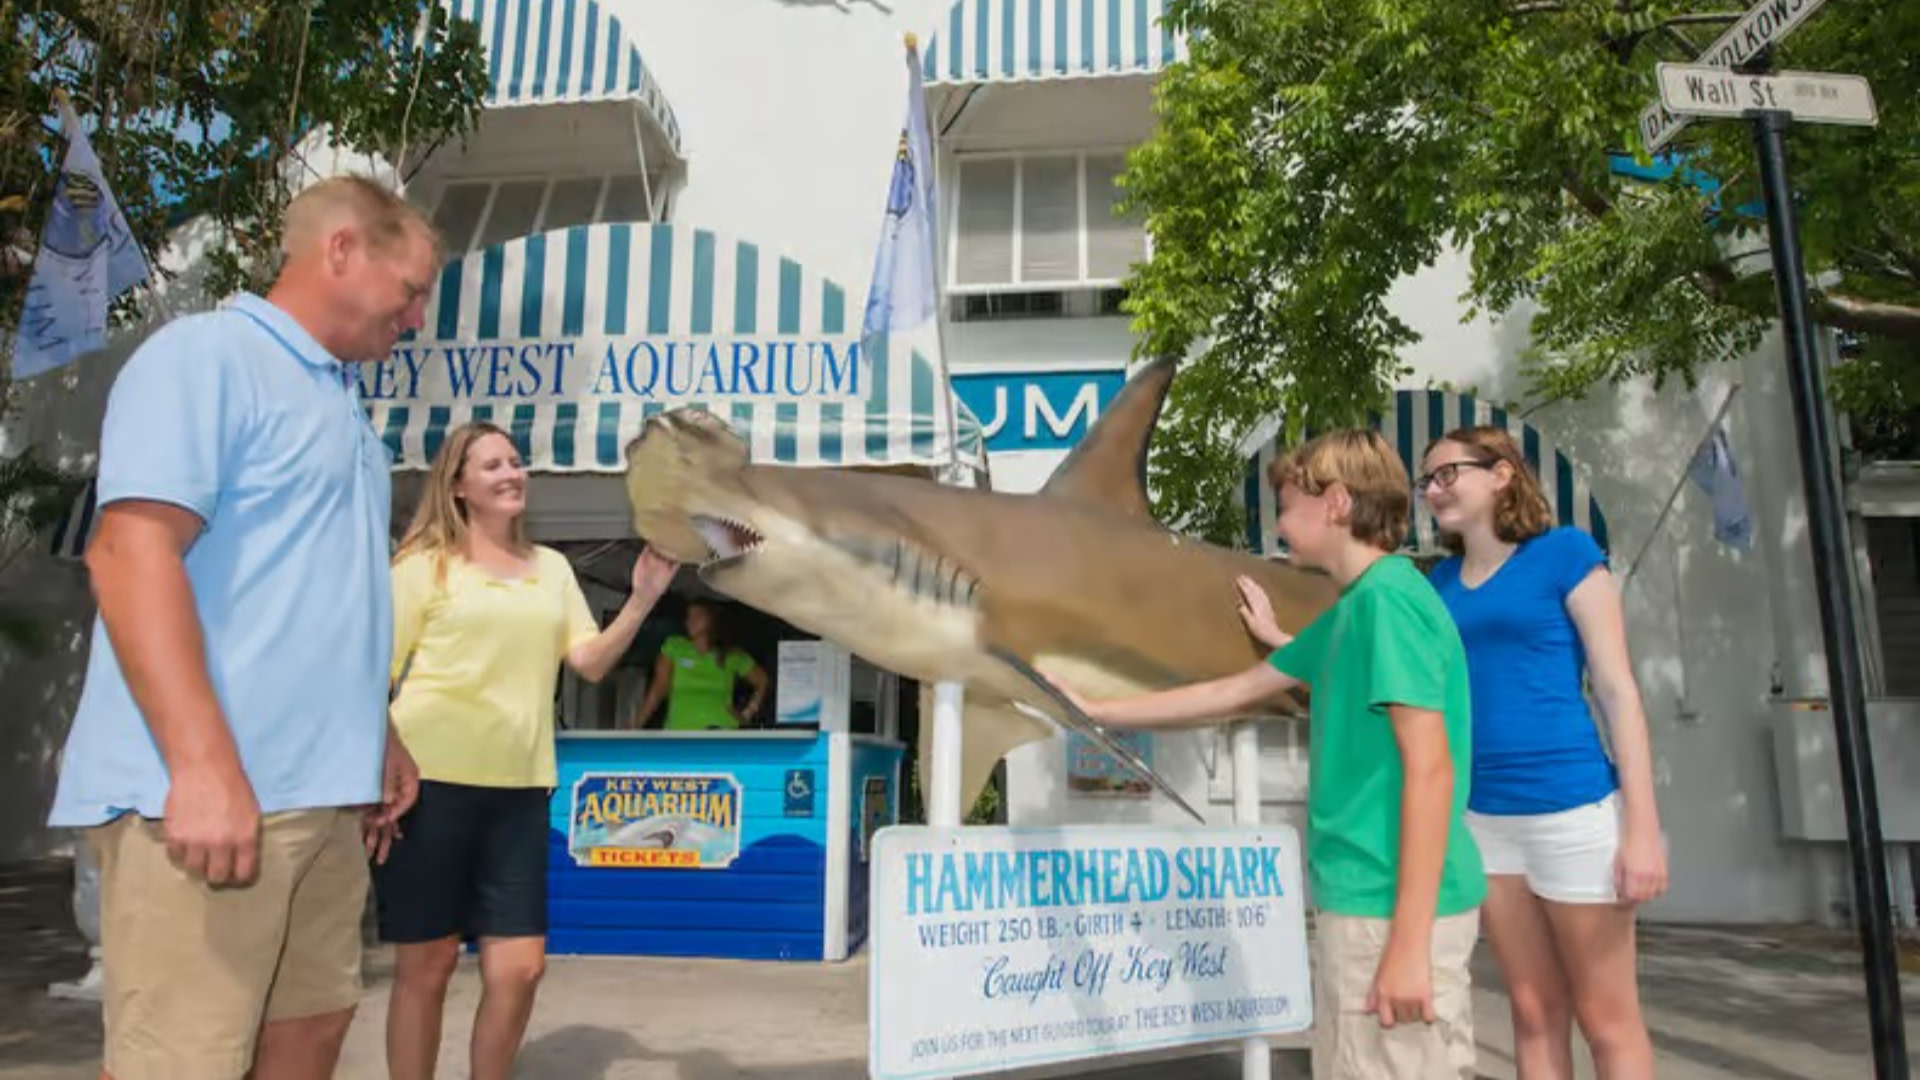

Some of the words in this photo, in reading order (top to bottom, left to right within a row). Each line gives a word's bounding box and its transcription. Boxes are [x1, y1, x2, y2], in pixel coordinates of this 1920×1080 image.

[1685, 75, 1737, 105] Wall
[1748, 80, 1778, 107] St
[443, 342, 575, 398] WEST
[591, 340, 861, 398] AQUARIUM
[606, 777, 647, 791] KEY
[651, 777, 711, 791] WEST
[578, 792, 732, 833] AQUARIUM
[597, 850, 696, 865] TICKETS
[905, 847, 1170, 915] HAMMERHEAD
[1176, 846, 1284, 900] SHARK
[919, 920, 991, 948] WEIGHT
[998, 917, 1032, 943] 250
[1074, 910, 1124, 937] GIRTH
[983, 955, 1066, 1003] Caught
[1073, 949, 1114, 996] Off
[1120, 944, 1173, 993] Key
[1178, 940, 1228, 977] West
[988, 1027, 1008, 1048] THE
[1010, 1024, 1039, 1045] NEXT
[1136, 1006, 1159, 1029] THE
[1163, 1003, 1186, 1027] KEY
[1190, 1001, 1223, 1024] WEST
